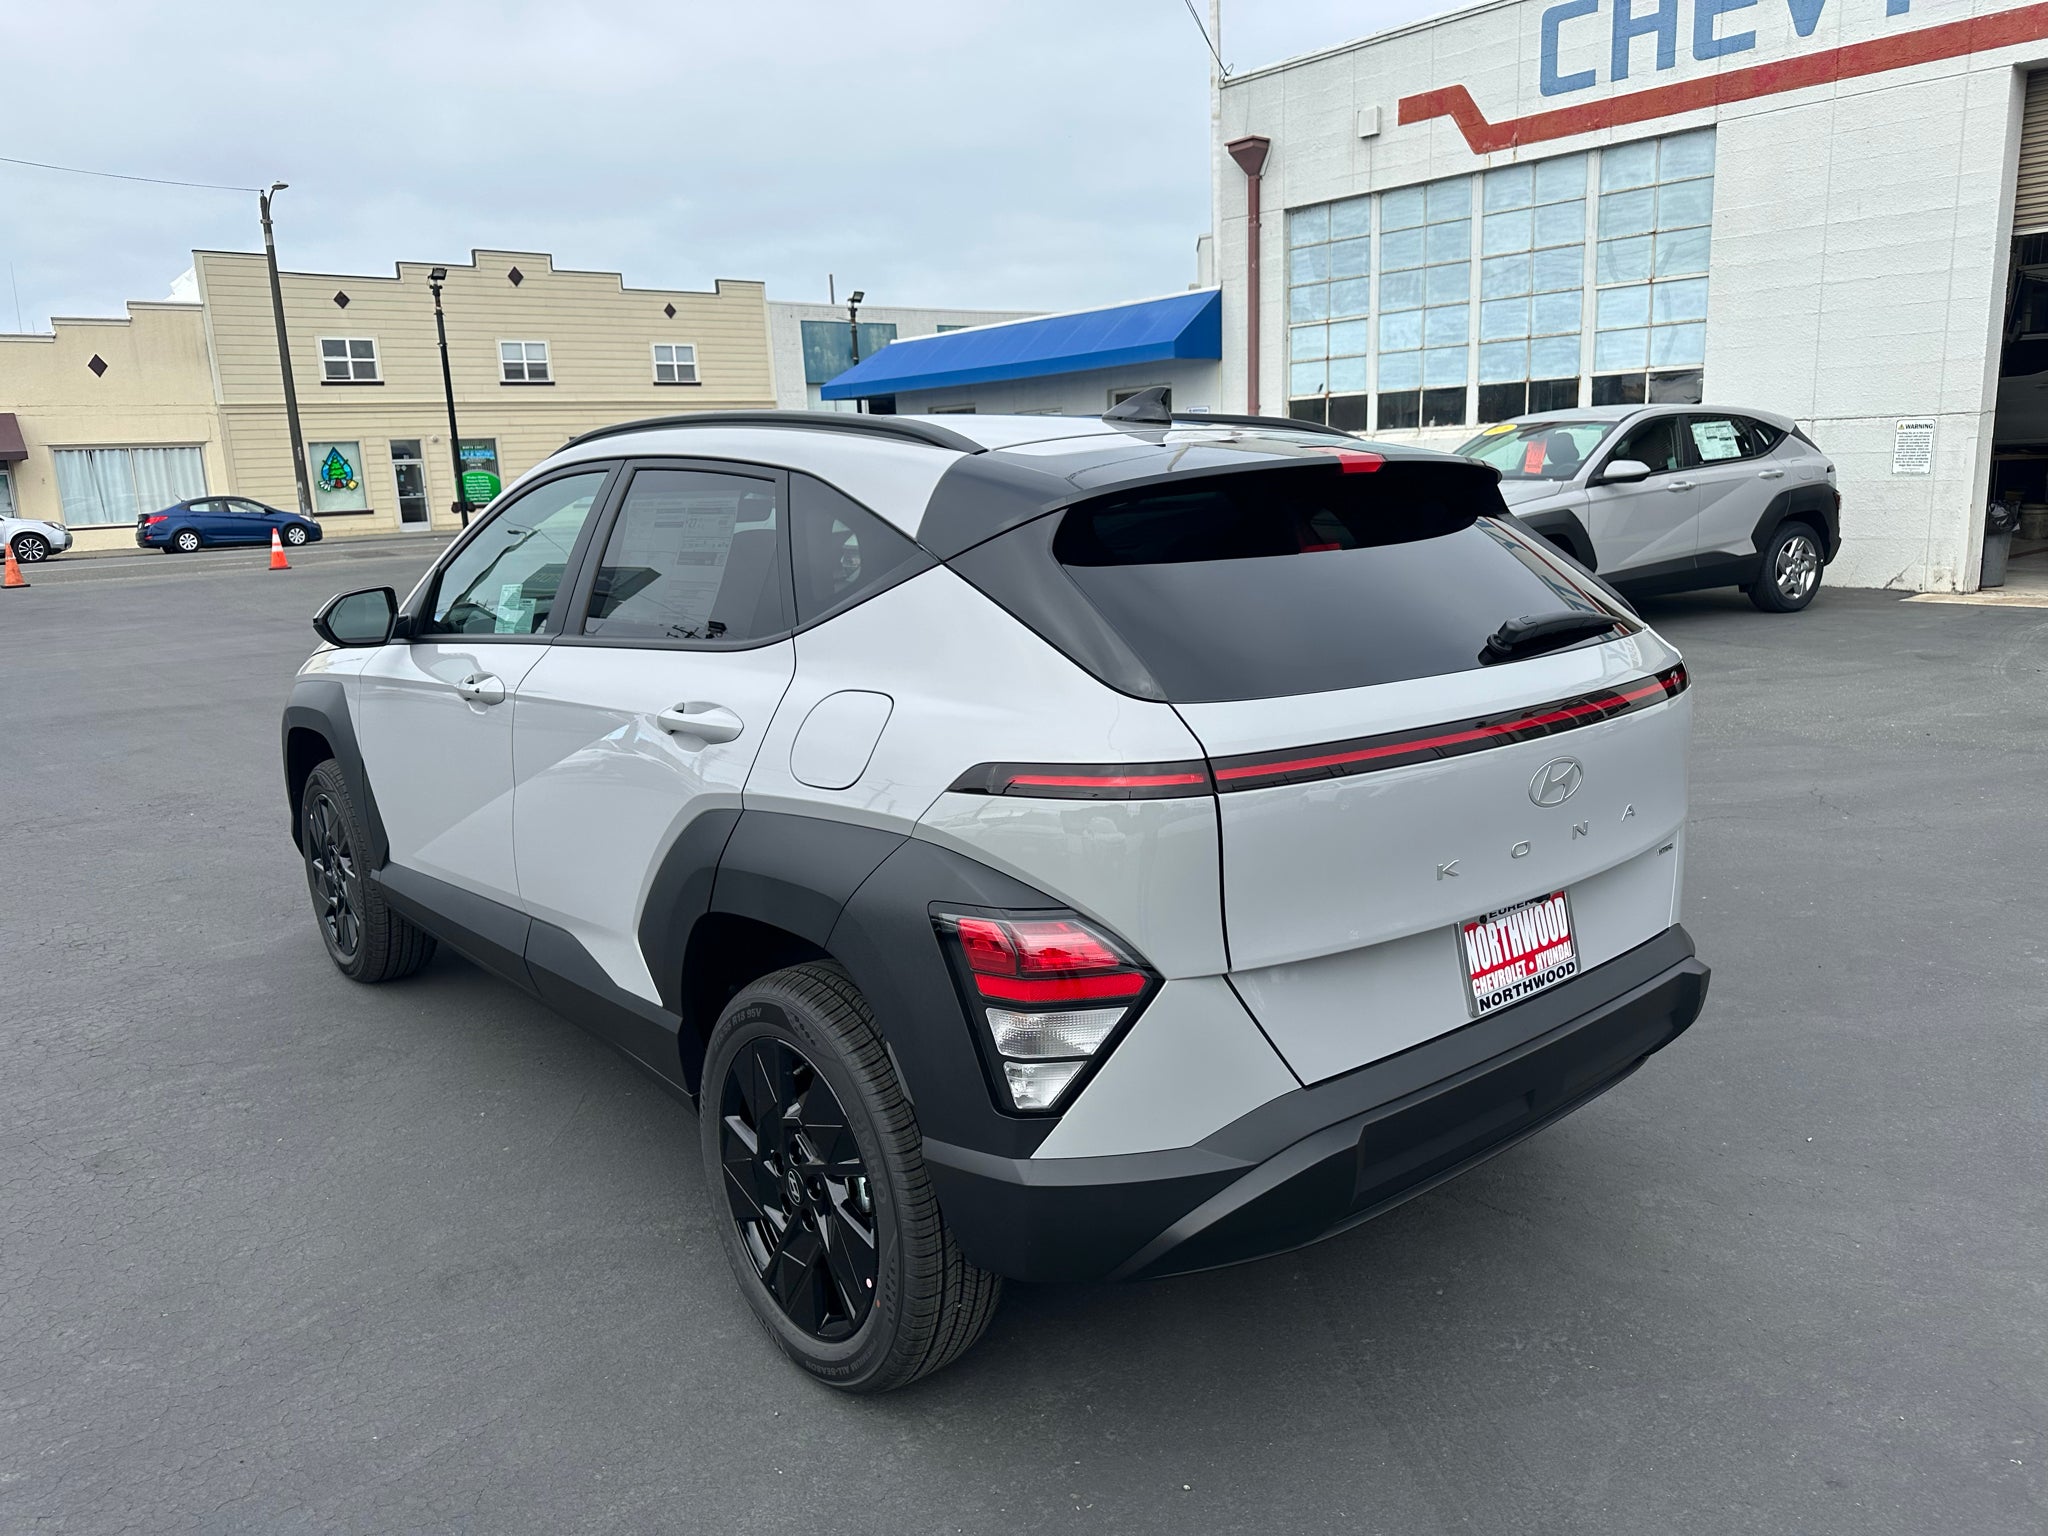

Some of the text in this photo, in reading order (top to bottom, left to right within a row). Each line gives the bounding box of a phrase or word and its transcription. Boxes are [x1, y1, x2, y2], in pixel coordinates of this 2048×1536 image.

[1540, 0, 1910, 97] CHE
[1436, 803, 1636, 881] KONA
[1464, 896, 1569, 976] NORTHWOOD
[1472, 940, 1573, 998] CHEVROLET HYUNDAI
[746, 1007, 762, 1018] 95V
[1479, 961, 1576, 1012] NORTHWOOD
